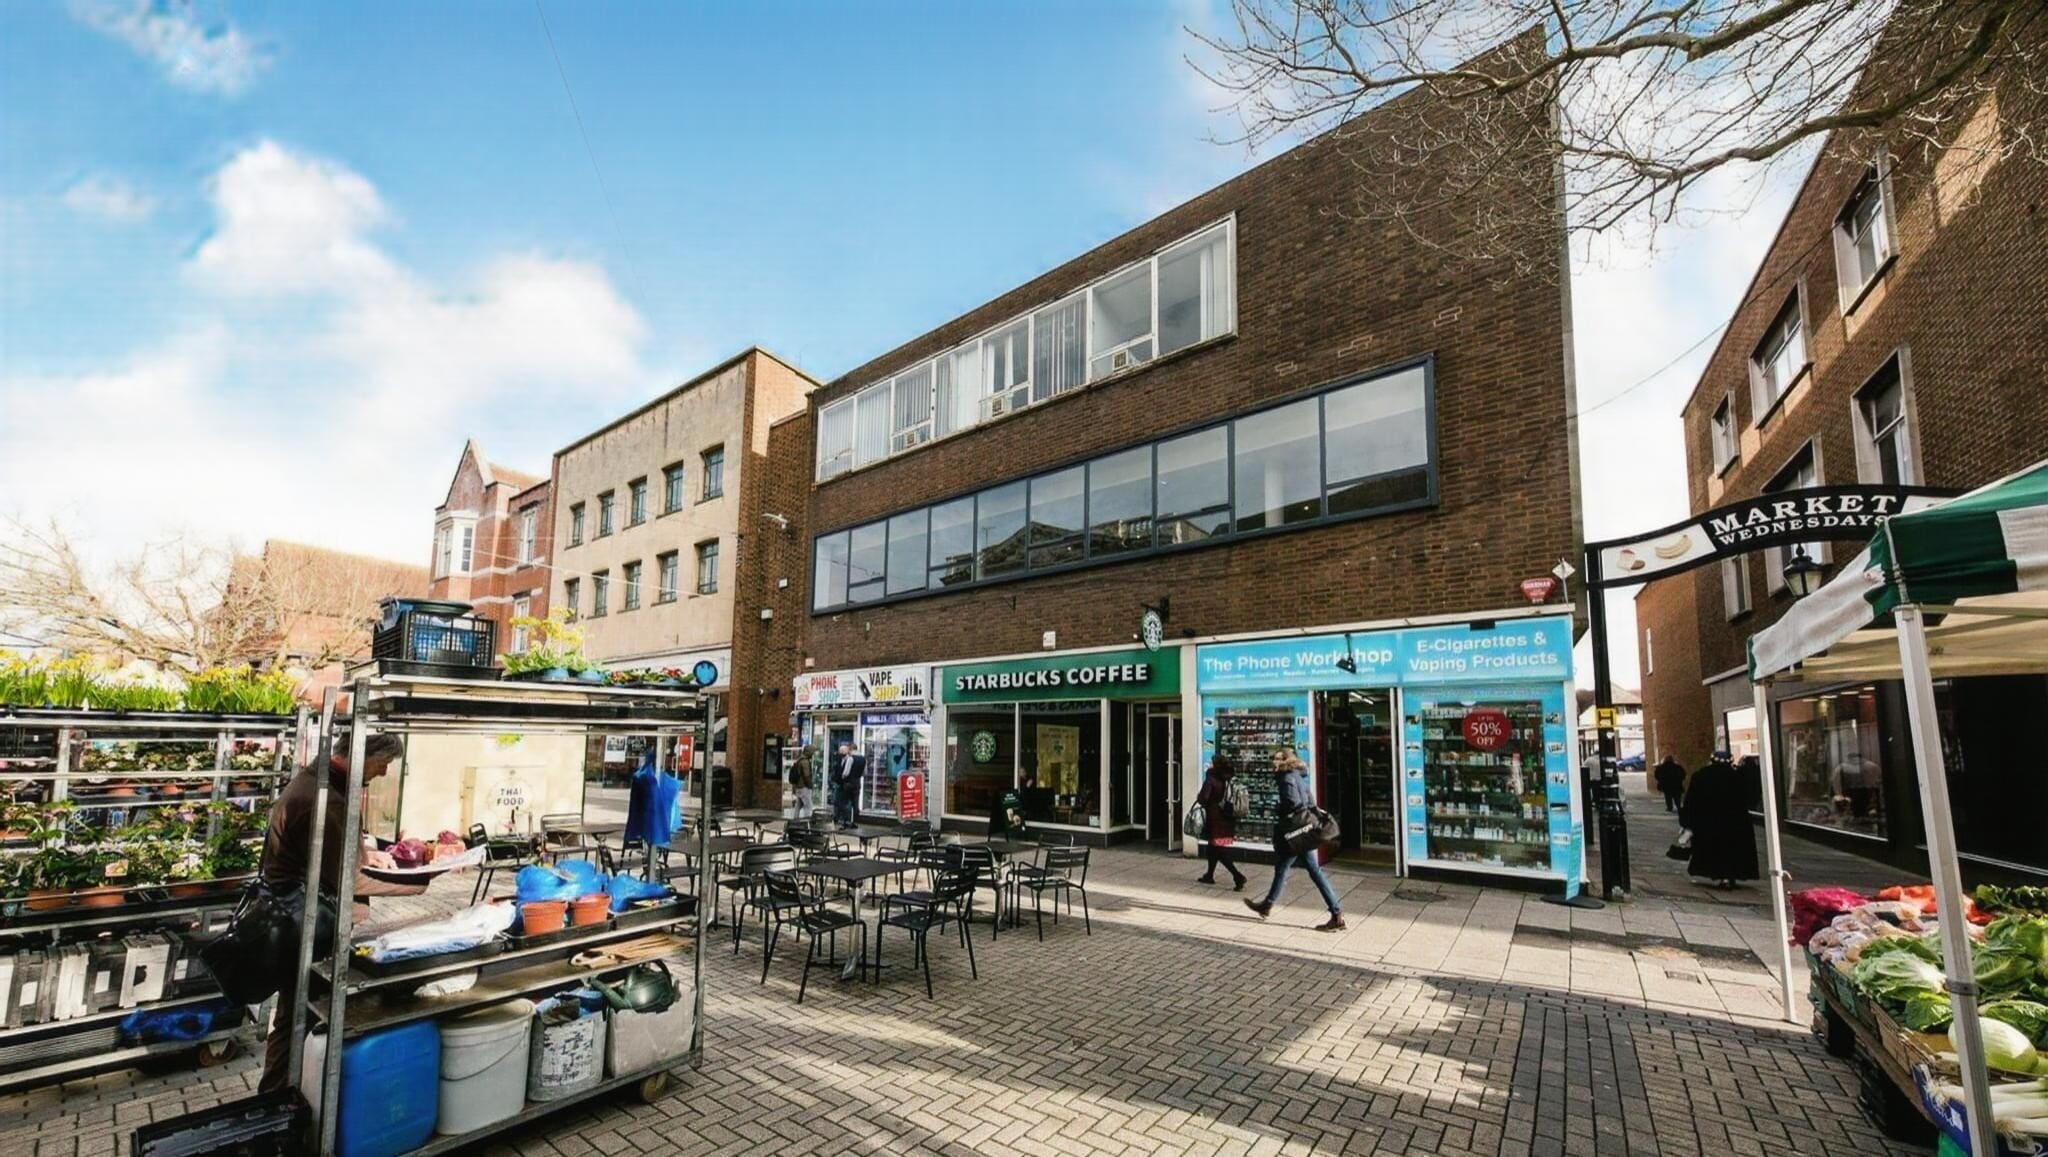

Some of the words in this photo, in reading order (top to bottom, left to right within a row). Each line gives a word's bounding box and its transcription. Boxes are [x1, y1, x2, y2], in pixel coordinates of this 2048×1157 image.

[1709, 494, 1897, 536] MARKET
[1718, 514, 1886, 546] WEDNESDAYS
[1416, 633, 1527, 654] E-Cigarettes
[1533, 631, 1547, 646] &
[1203, 657, 1233, 674] The
[1237, 655, 1291, 671] Phone
[1409, 657, 1467, 673] Vaping
[1472, 651, 1558, 669] Products
[810, 675, 837, 690] PHONE
[869, 671, 892, 685] VAPE
[955, 669, 1061, 691] STARBUCKS
[1066, 663, 1149, 685] COFFEE
[818, 689, 841, 703] SHOP
[874, 686, 899, 701] SHOP
[1470, 722, 1502, 736] 50%
[1477, 736, 1495, 745] OFF
[500, 788, 522, 796] THAI
[496, 797, 525, 806] FOOD
